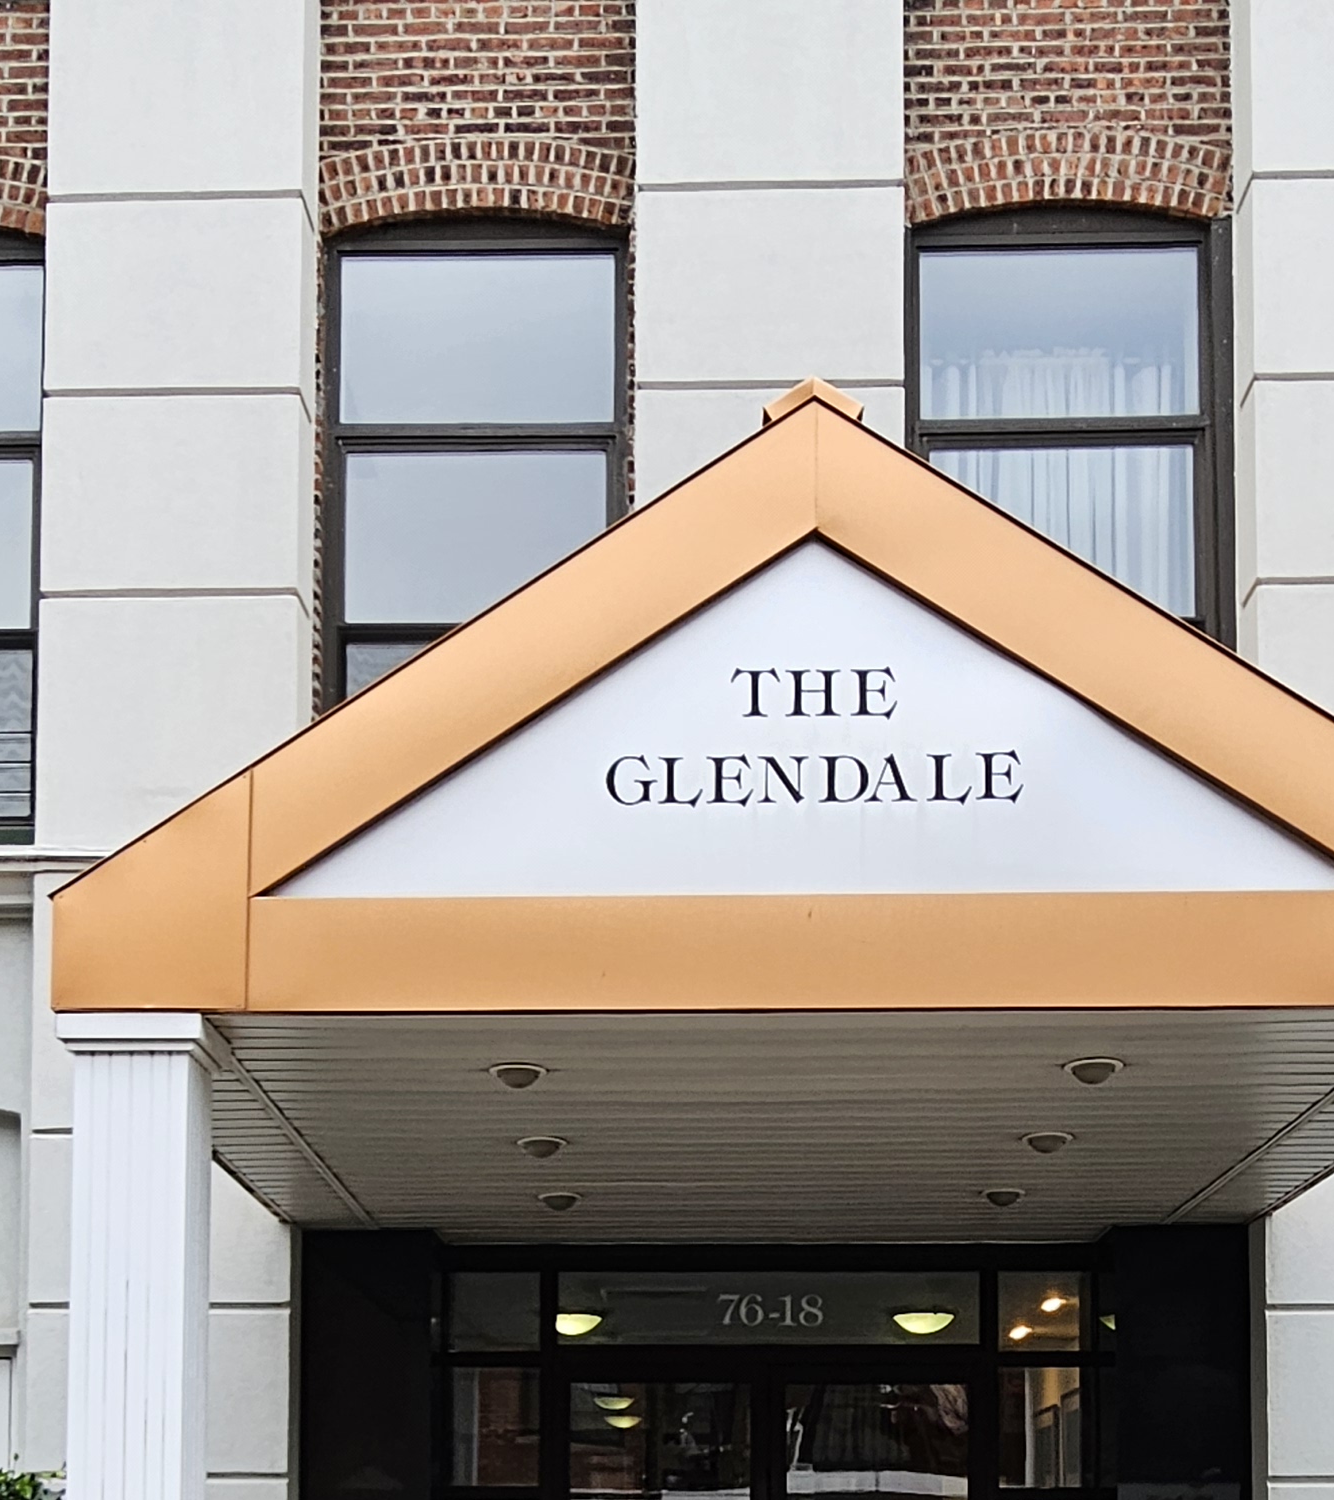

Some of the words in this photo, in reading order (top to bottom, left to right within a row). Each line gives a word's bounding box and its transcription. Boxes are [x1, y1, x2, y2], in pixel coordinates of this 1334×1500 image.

[730, 665, 898, 720] THE
[605, 749, 1025, 808] GLENDALE
[716, 1293, 825, 1328] 76-18
